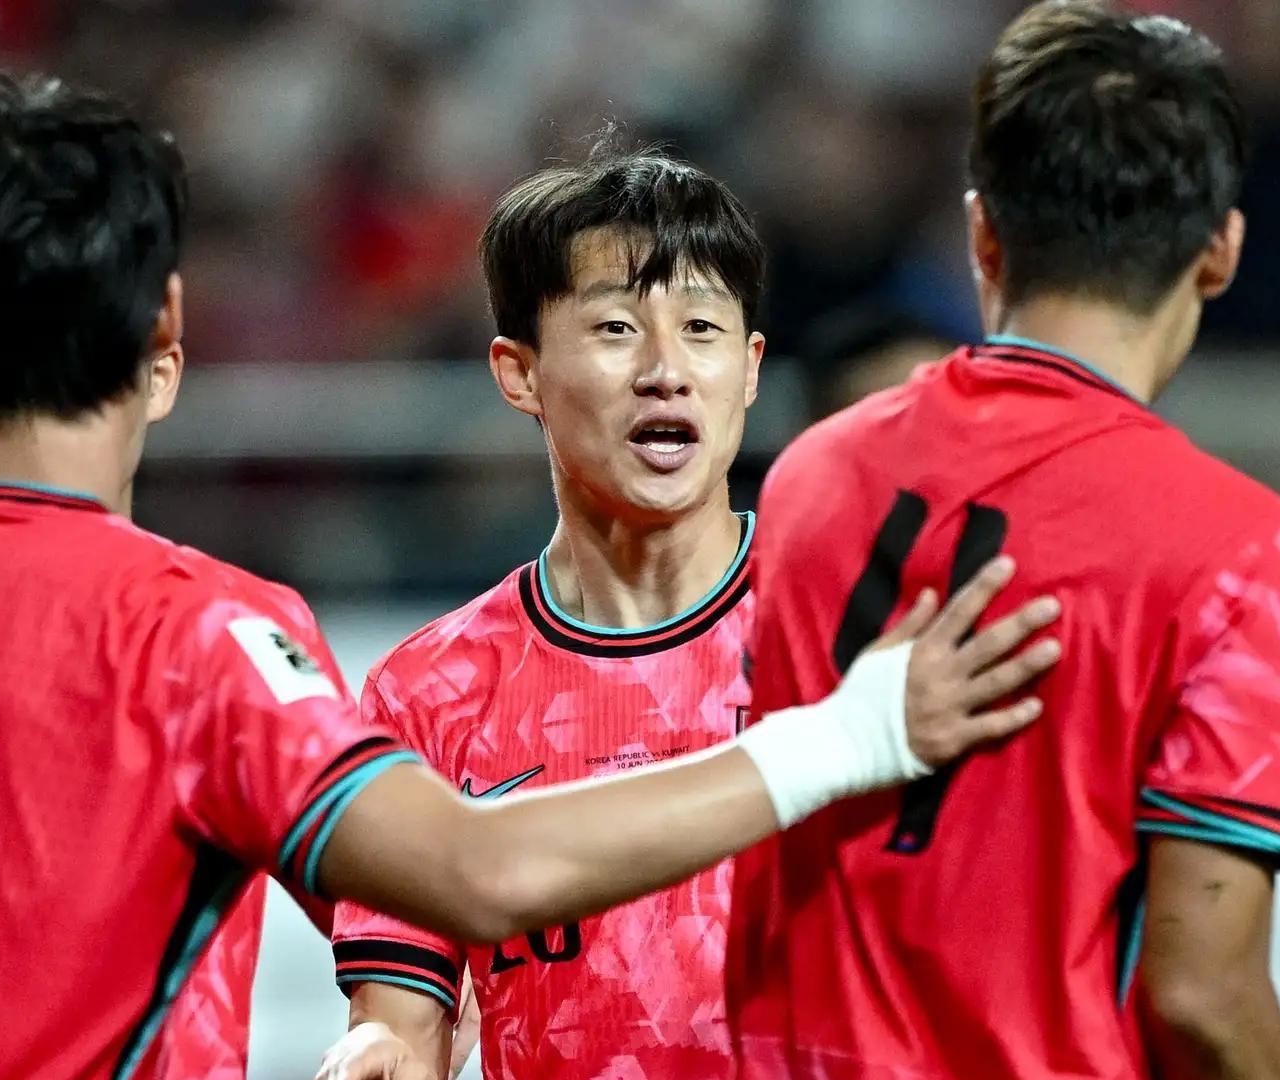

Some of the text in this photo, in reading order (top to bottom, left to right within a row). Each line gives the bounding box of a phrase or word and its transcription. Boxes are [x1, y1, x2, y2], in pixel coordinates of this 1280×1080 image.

[585, 755, 611, 766] KOREA
[613, 750, 649, 762] REPUBLIC
[661, 744, 691, 758] KUWAIT
